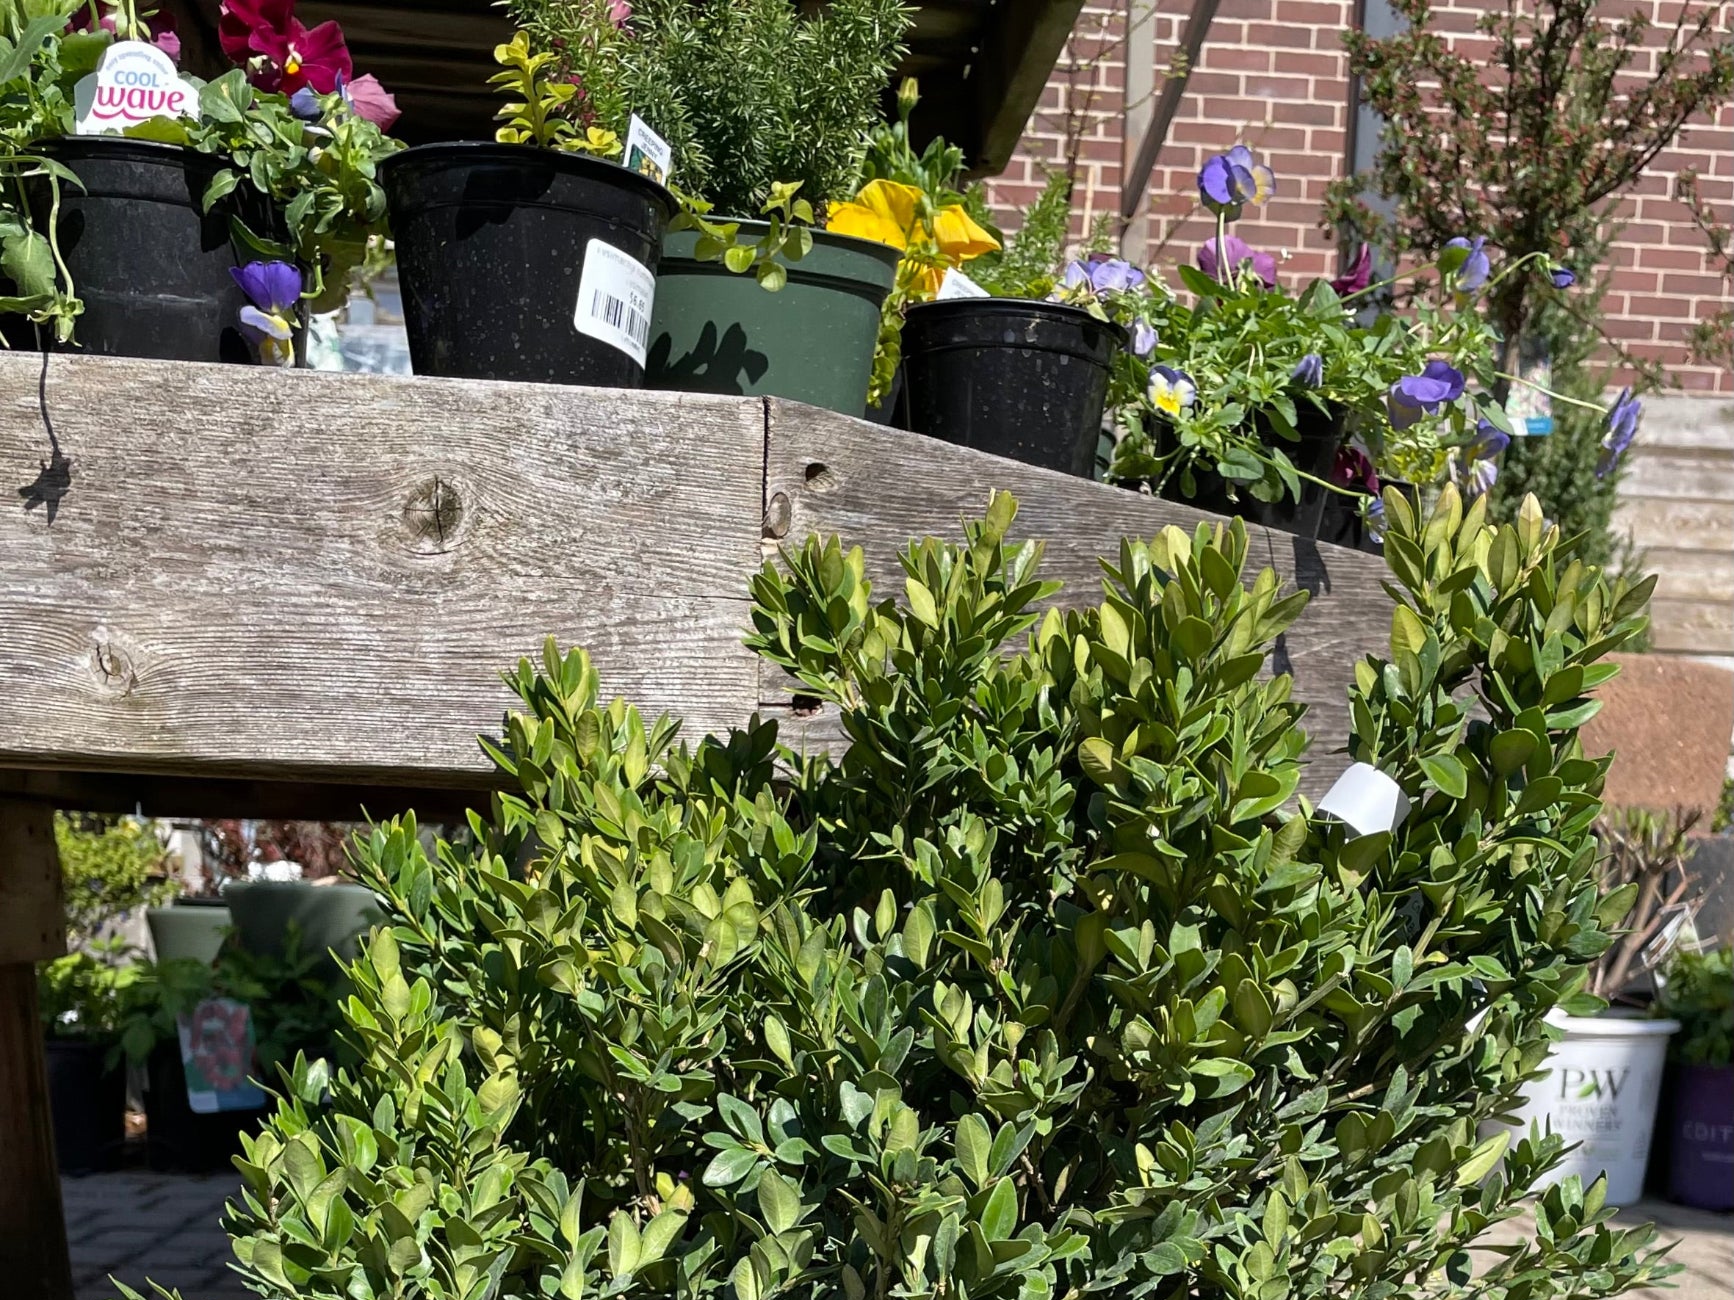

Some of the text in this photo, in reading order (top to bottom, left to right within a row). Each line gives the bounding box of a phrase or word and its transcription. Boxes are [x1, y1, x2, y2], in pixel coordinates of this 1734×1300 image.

[114, 70, 160, 88] COOL
[97, 86, 185, 112] wave
[637, 128, 663, 156] CREEPING
[1559, 1066, 1632, 1101] PW
[1559, 1104, 1619, 1117] PROVEN
